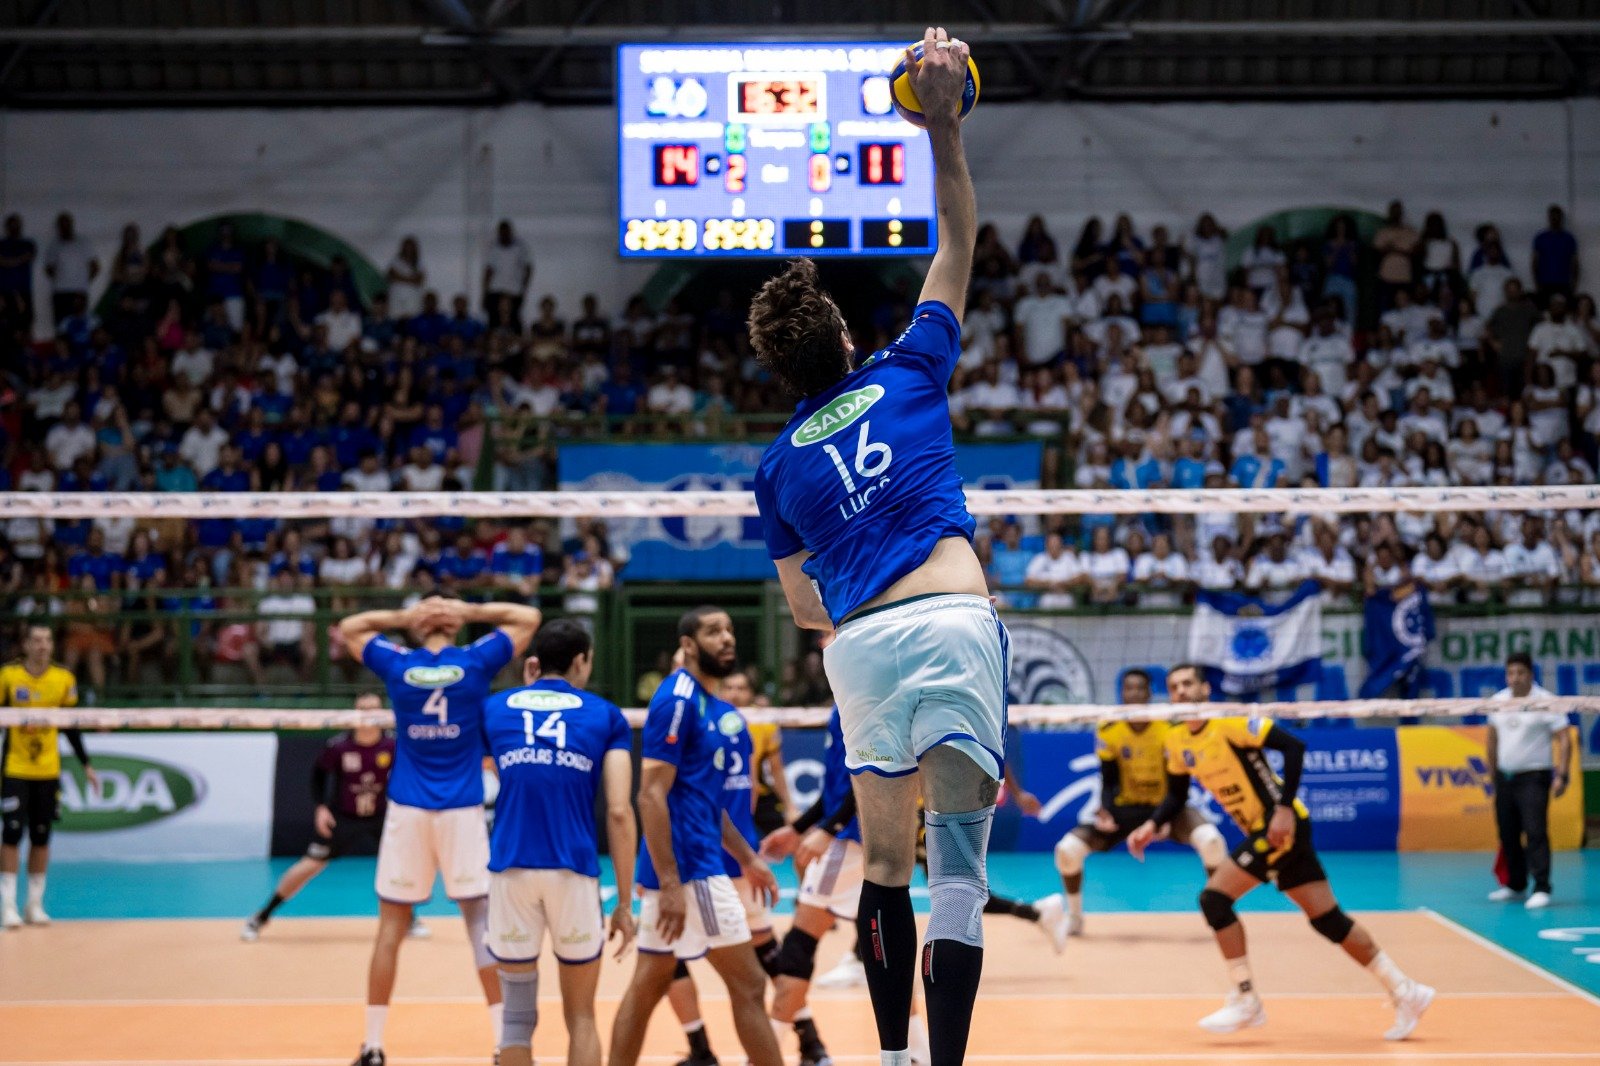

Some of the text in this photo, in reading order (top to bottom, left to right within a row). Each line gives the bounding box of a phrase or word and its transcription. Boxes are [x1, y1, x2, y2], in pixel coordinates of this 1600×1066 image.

[661, 145, 698, 184] 14
[726, 154, 746, 191] 2
[809, 154, 830, 191] 0
[868, 144, 904, 183] 11
[803, 394, 873, 439] SADA
[823, 420, 892, 494] 16
[1441, 628, 1600, 662] ORGAN
[422, 687, 448, 726] 4
[522, 710, 566, 749] 14
[499, 747, 553, 770] DOUGLAS
[58, 769, 176, 813] ADA
